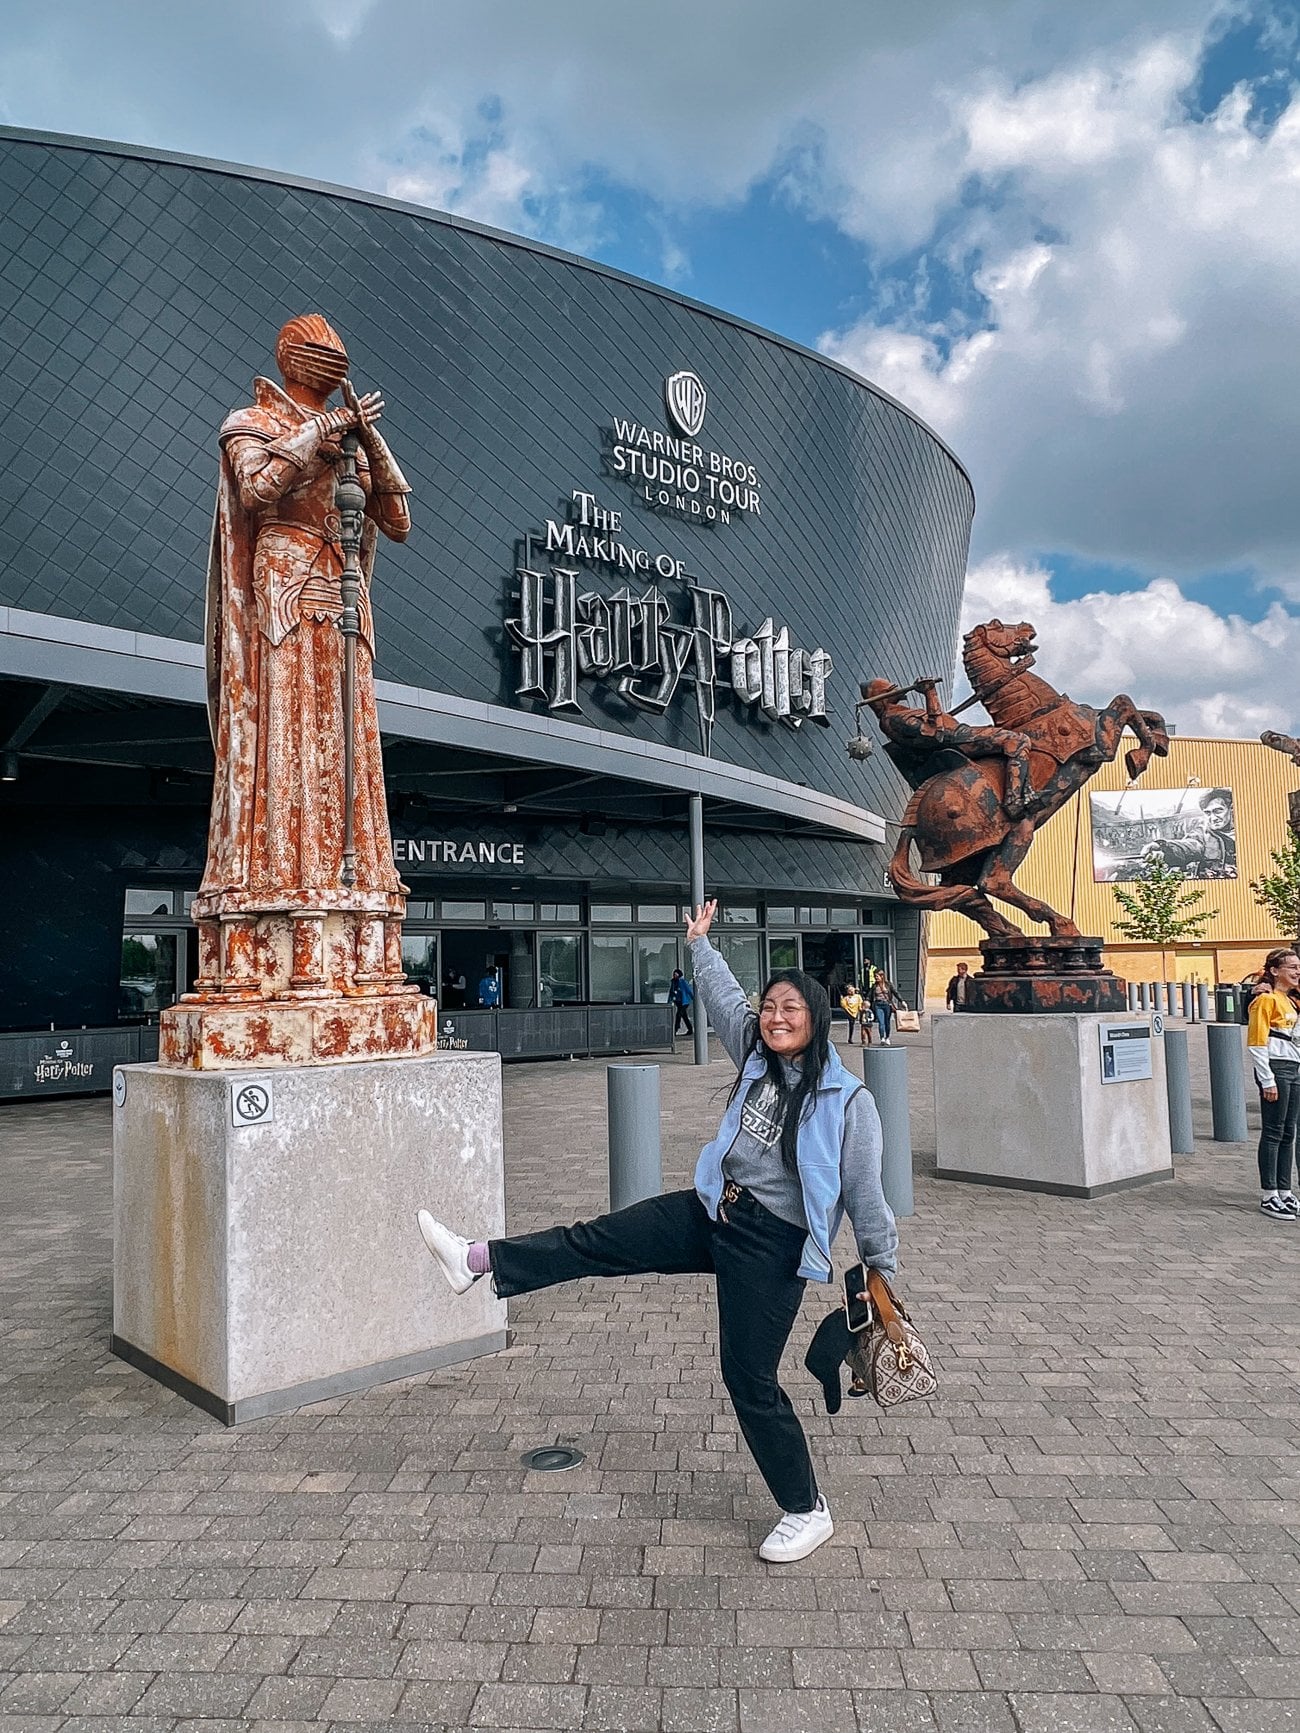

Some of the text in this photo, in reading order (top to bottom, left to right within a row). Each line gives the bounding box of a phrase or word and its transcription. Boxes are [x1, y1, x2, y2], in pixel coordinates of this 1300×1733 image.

[613, 417, 761, 488] WARNER BROS.
[613, 446, 761, 514] STUDIO TOUR
[645, 486, 730, 524] LONDON
[545, 519, 686, 579] MAKING OF
[504, 567, 834, 757] Harry Potter
[393, 839, 524, 864] ENTRANCE
[34, 1061, 94, 1082] Harry Potter
